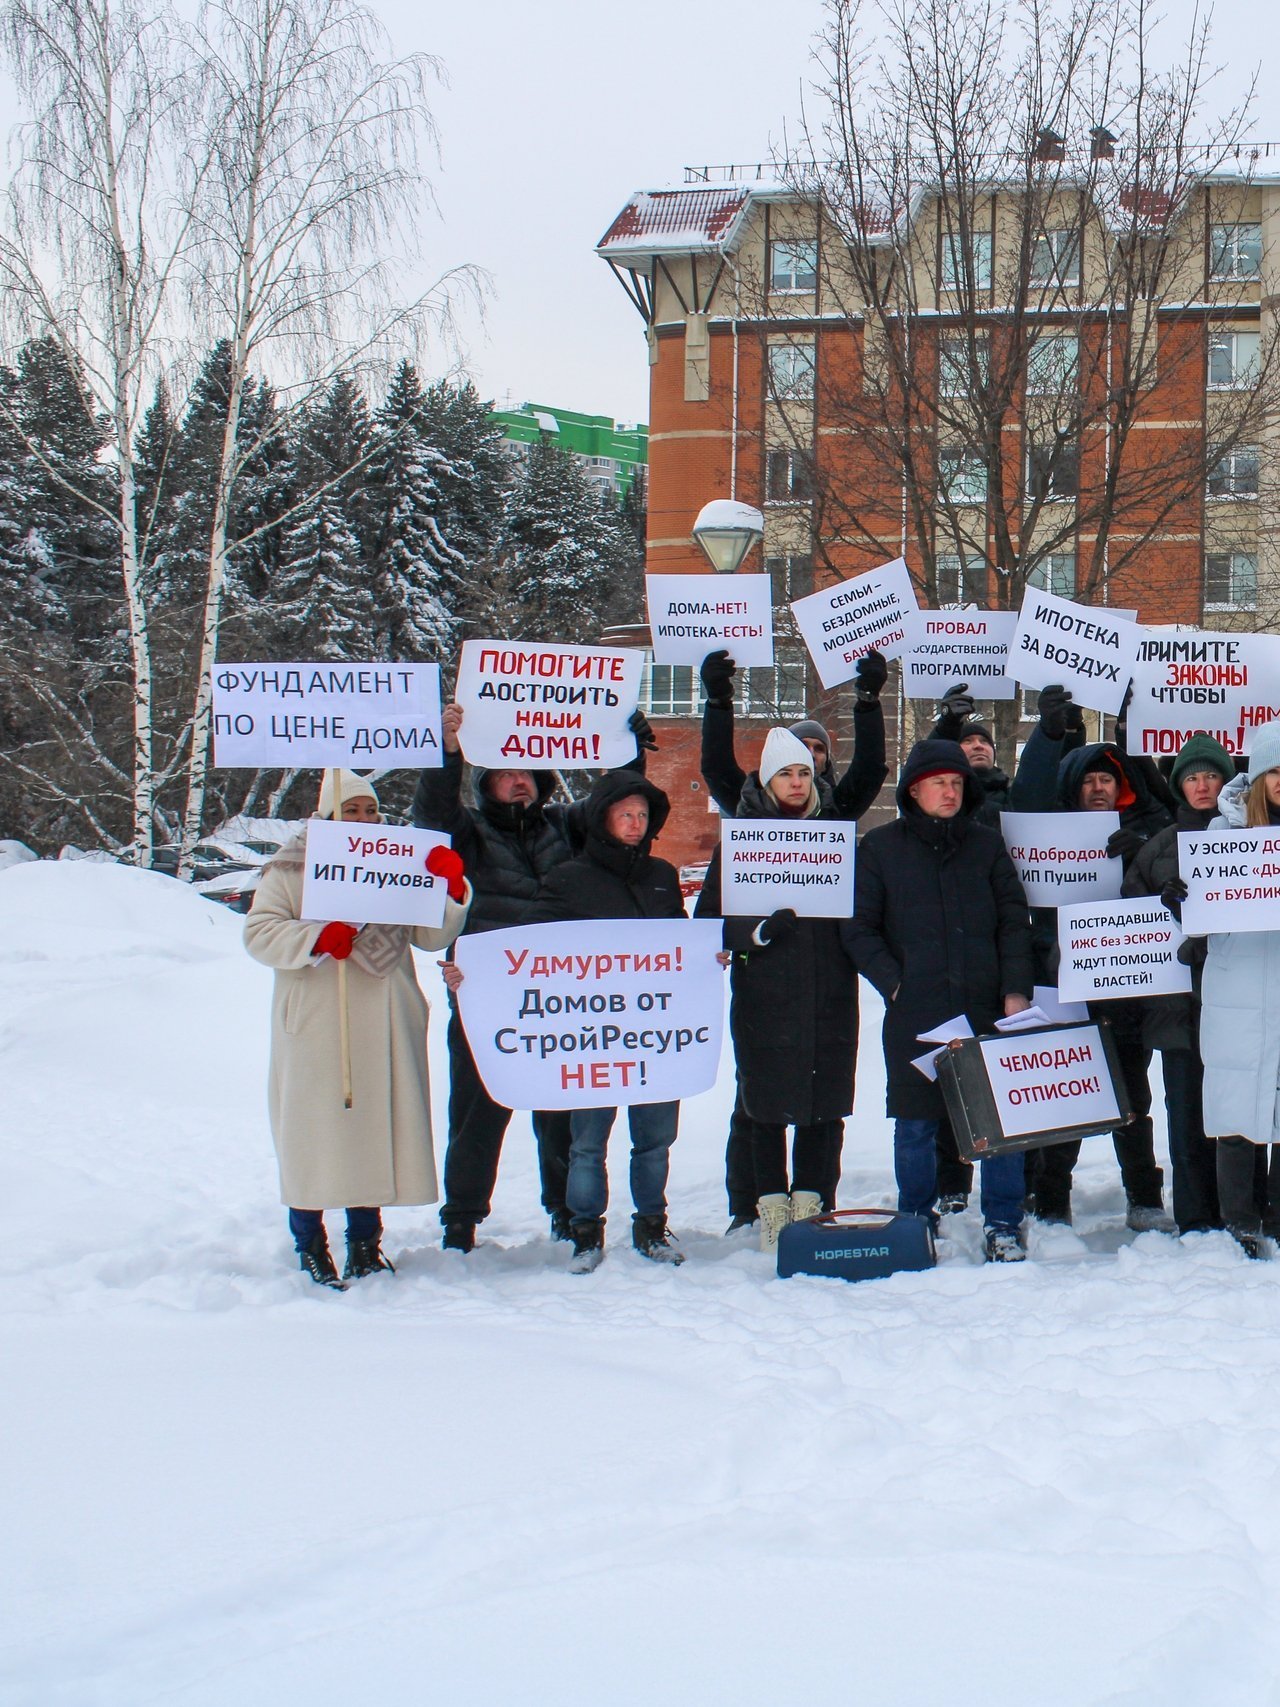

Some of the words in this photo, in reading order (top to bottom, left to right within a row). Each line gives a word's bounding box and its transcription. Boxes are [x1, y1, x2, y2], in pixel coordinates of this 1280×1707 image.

[830, 583, 873, 609] СЕМЬИ
[668, 601, 747, 616] ДОМА-НЕТ!
[822, 593, 900, 632] БЕЗДОМНЫЕ,
[658, 624, 763, 638] ИПОТЕКА-ЕСТЬ!
[822, 610, 902, 652] МОШЕННИКИ
[926, 622, 987, 635] ПРОВАЛ
[1034, 605, 1120, 649] ИПОТЕКА
[843, 629, 905, 663] БАНКРОТЫ
[909, 643, 1008, 655] ОСУДАРСТВЕННОЙ
[1136, 641, 1240, 663] ПРИМИТЕ
[479, 650, 625, 681] ПОМОГИТЕ
[1020, 634, 1040, 656] ЗА
[1043, 643, 1121, 683] ВОЗДУХ
[911, 663, 1005, 677] ПРОГРАММЫ
[1166, 664, 1248, 687] ЗАКОНЫ
[217, 670, 414, 698] ФУНДАМЕНТ
[478, 681, 619, 706] ДОСТРОИТЬ
[1152, 687, 1226, 704] ЧТОБЫ
[516, 710, 581, 729] НАШИ
[215, 714, 254, 735] ПО
[272, 716, 345, 743] ЦЕНЕ
[352, 727, 438, 754] ДОМА
[501, 734, 601, 760] ДОМА!
[348, 836, 414, 857] Урбан
[731, 830, 765, 843] БАНК
[767, 831, 826, 844] ОТВЕТИТ
[829, 832, 846, 844] ЗА
[733, 851, 842, 865] АККРЕДИТАЦИЮ
[1011, 847, 1026, 859] СК
[1189, 843, 1199, 855] У
[1202, 841, 1259, 855] ЭСКРОУ
[314, 863, 346, 882] ИП
[353, 866, 434, 889] Глухова
[734, 869, 840, 887] ЗАСТРОЙЩИКА?
[1022, 869, 1040, 882] ИП
[1044, 870, 1097, 885] Пушин
[1192, 868, 1202, 879] А
[1205, 867, 1215, 878] У
[1219, 865, 1248, 877] НАС
[1205, 892, 1221, 902] от
[1070, 911, 1170, 930] ПОСТРАДАВШИЕ
[1071, 937, 1098, 950] ИЖС
[1100, 935, 1121, 947] без
[1123, 931, 1172, 946] ЭСКРОУ
[504, 946, 683, 980] Удмуртия!
[1073, 956, 1106, 970] ЖДУТ
[1110, 952, 1172, 968] ПОМОЩИ
[1093, 973, 1153, 988] ВЛАСТЕЙ!
[519, 989, 626, 1019] Домов
[637, 992, 673, 1011] от
[495, 1024, 709, 1059] СтройРесурс
[1000, 1045, 1092, 1073] ЧЕМОДАН
[560, 1061, 647, 1090] НЕТ!
[1008, 1076, 1101, 1106] ОТПИСОК!
[814, 1246, 889, 1261] HOPESTAR
